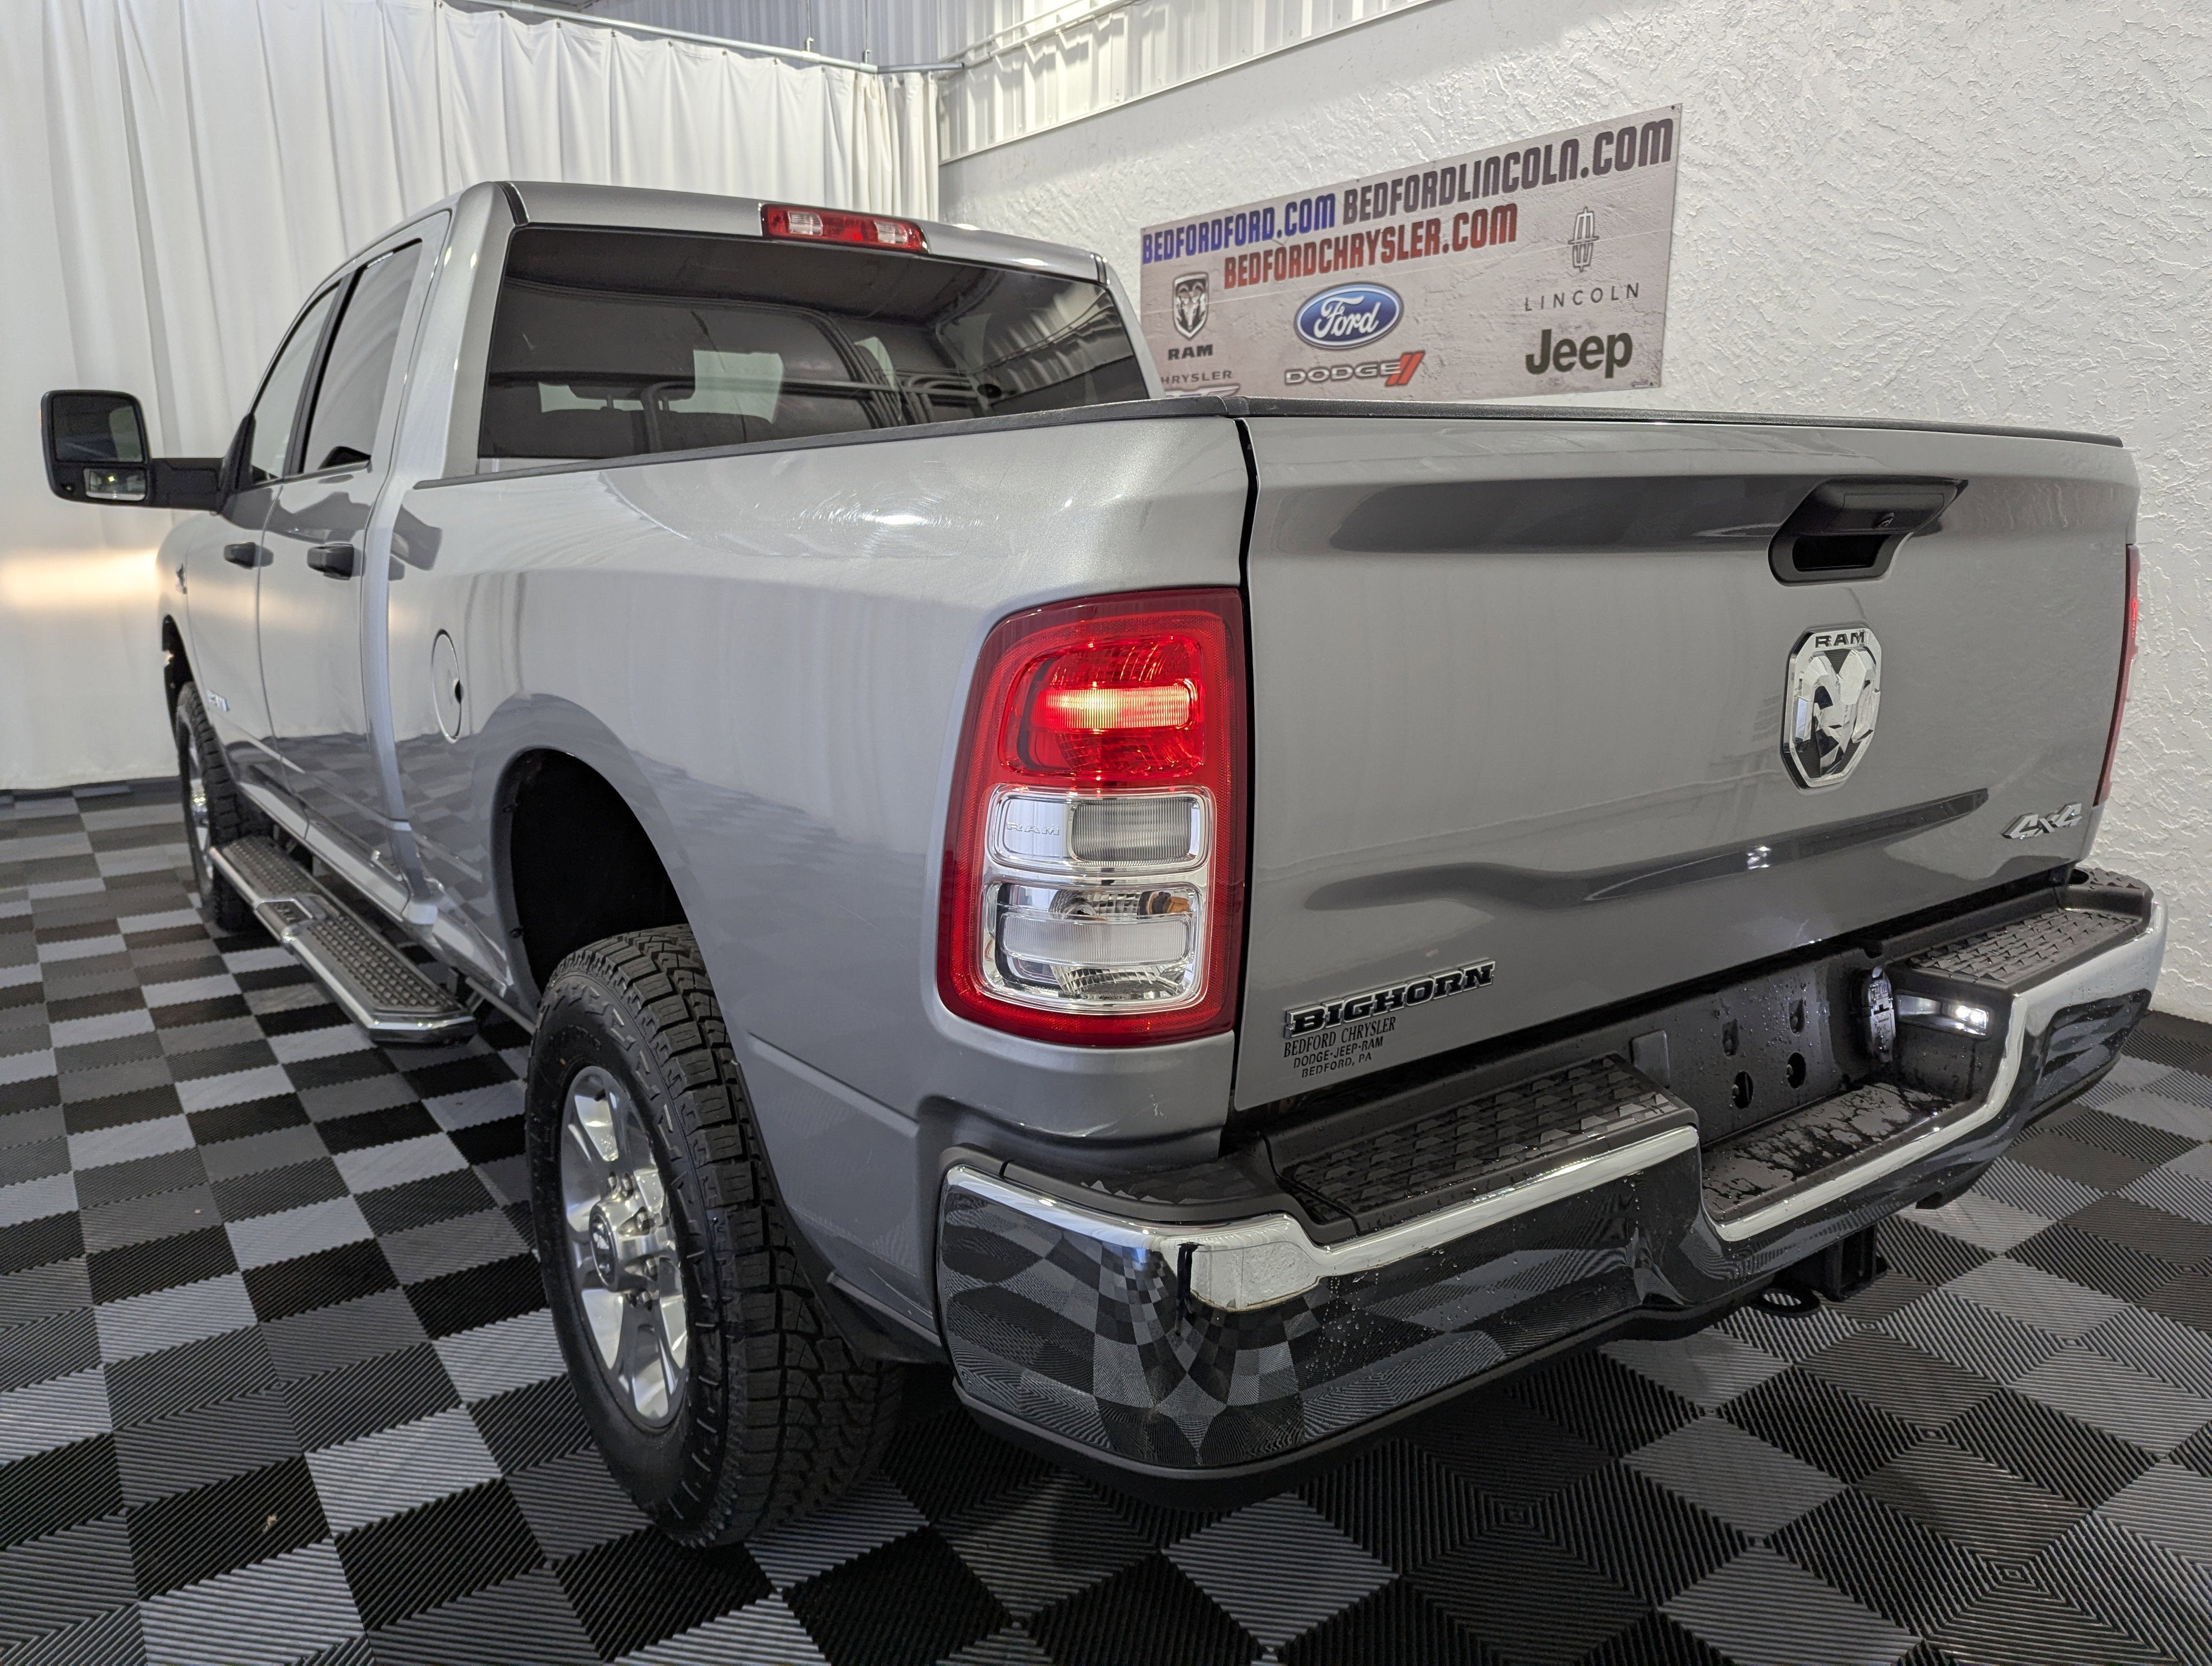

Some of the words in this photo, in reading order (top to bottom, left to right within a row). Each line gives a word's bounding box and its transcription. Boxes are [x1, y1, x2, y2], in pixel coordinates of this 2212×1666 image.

[1142, 193, 1336, 265] BEDFORDFORD.COM
[1343, 118, 1673, 225] BEDFORDLINCOLN.COM
[1224, 203, 1517, 290] BEDFORDCHRYSLER.COM
[1525, 282, 1639, 312] LINCOLN
[1313, 295, 1382, 338] Ford
[1168, 344, 1213, 361] RAM
[1525, 329, 1633, 379] Jeep
[1161, 370, 1232, 385] HRYSLER
[1284, 359, 1402, 386] DODGE
[1815, 631, 1865, 648] RAM
[1006, 821, 1060, 836] RAM
[1284, 1031, 1336, 1058] BEDFORD
[1341, 1016, 1396, 1043] CHRYSLER
[1302, 1059, 1355, 1078] BEDFORD,
[1359, 1052, 1372, 1063] PA
